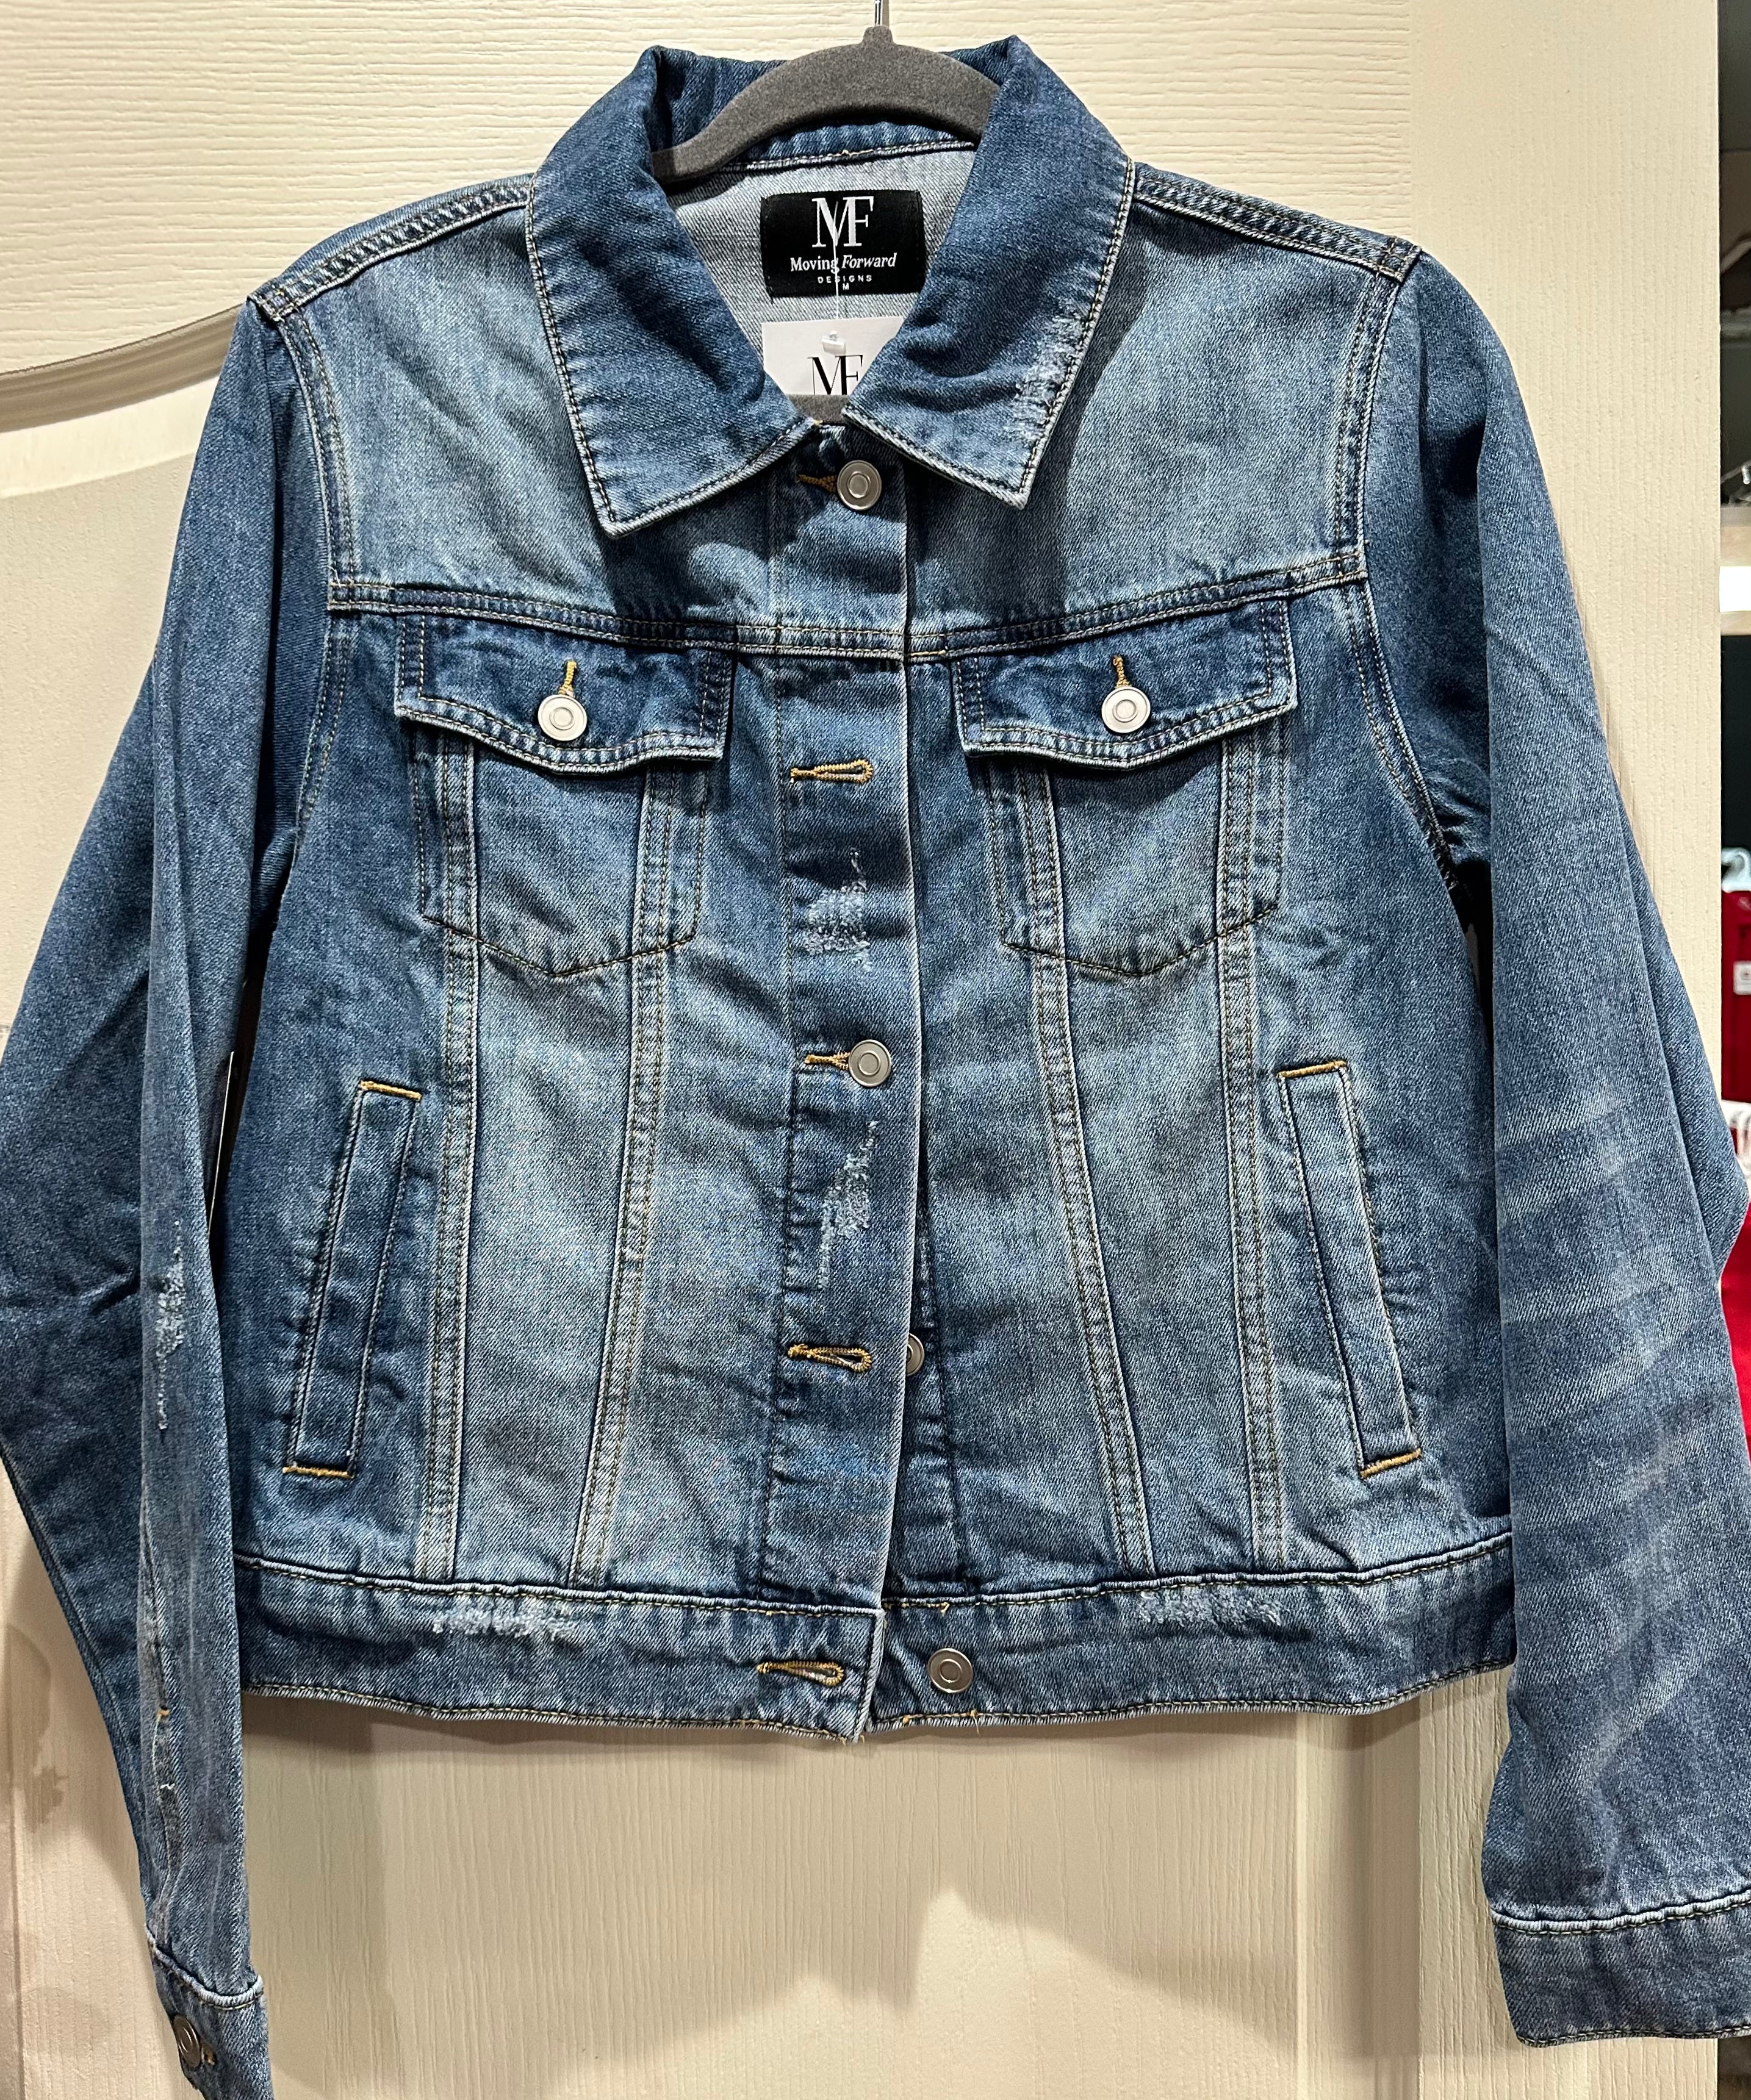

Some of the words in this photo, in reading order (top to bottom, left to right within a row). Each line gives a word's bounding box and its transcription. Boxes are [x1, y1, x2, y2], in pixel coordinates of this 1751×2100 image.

[811, 196, 874, 248] MF
[790, 256, 840, 274] Moving
[841, 253, 897, 268] Forward
[818, 274, 872, 284] DESIGNS
[807, 354, 863, 395] MF
